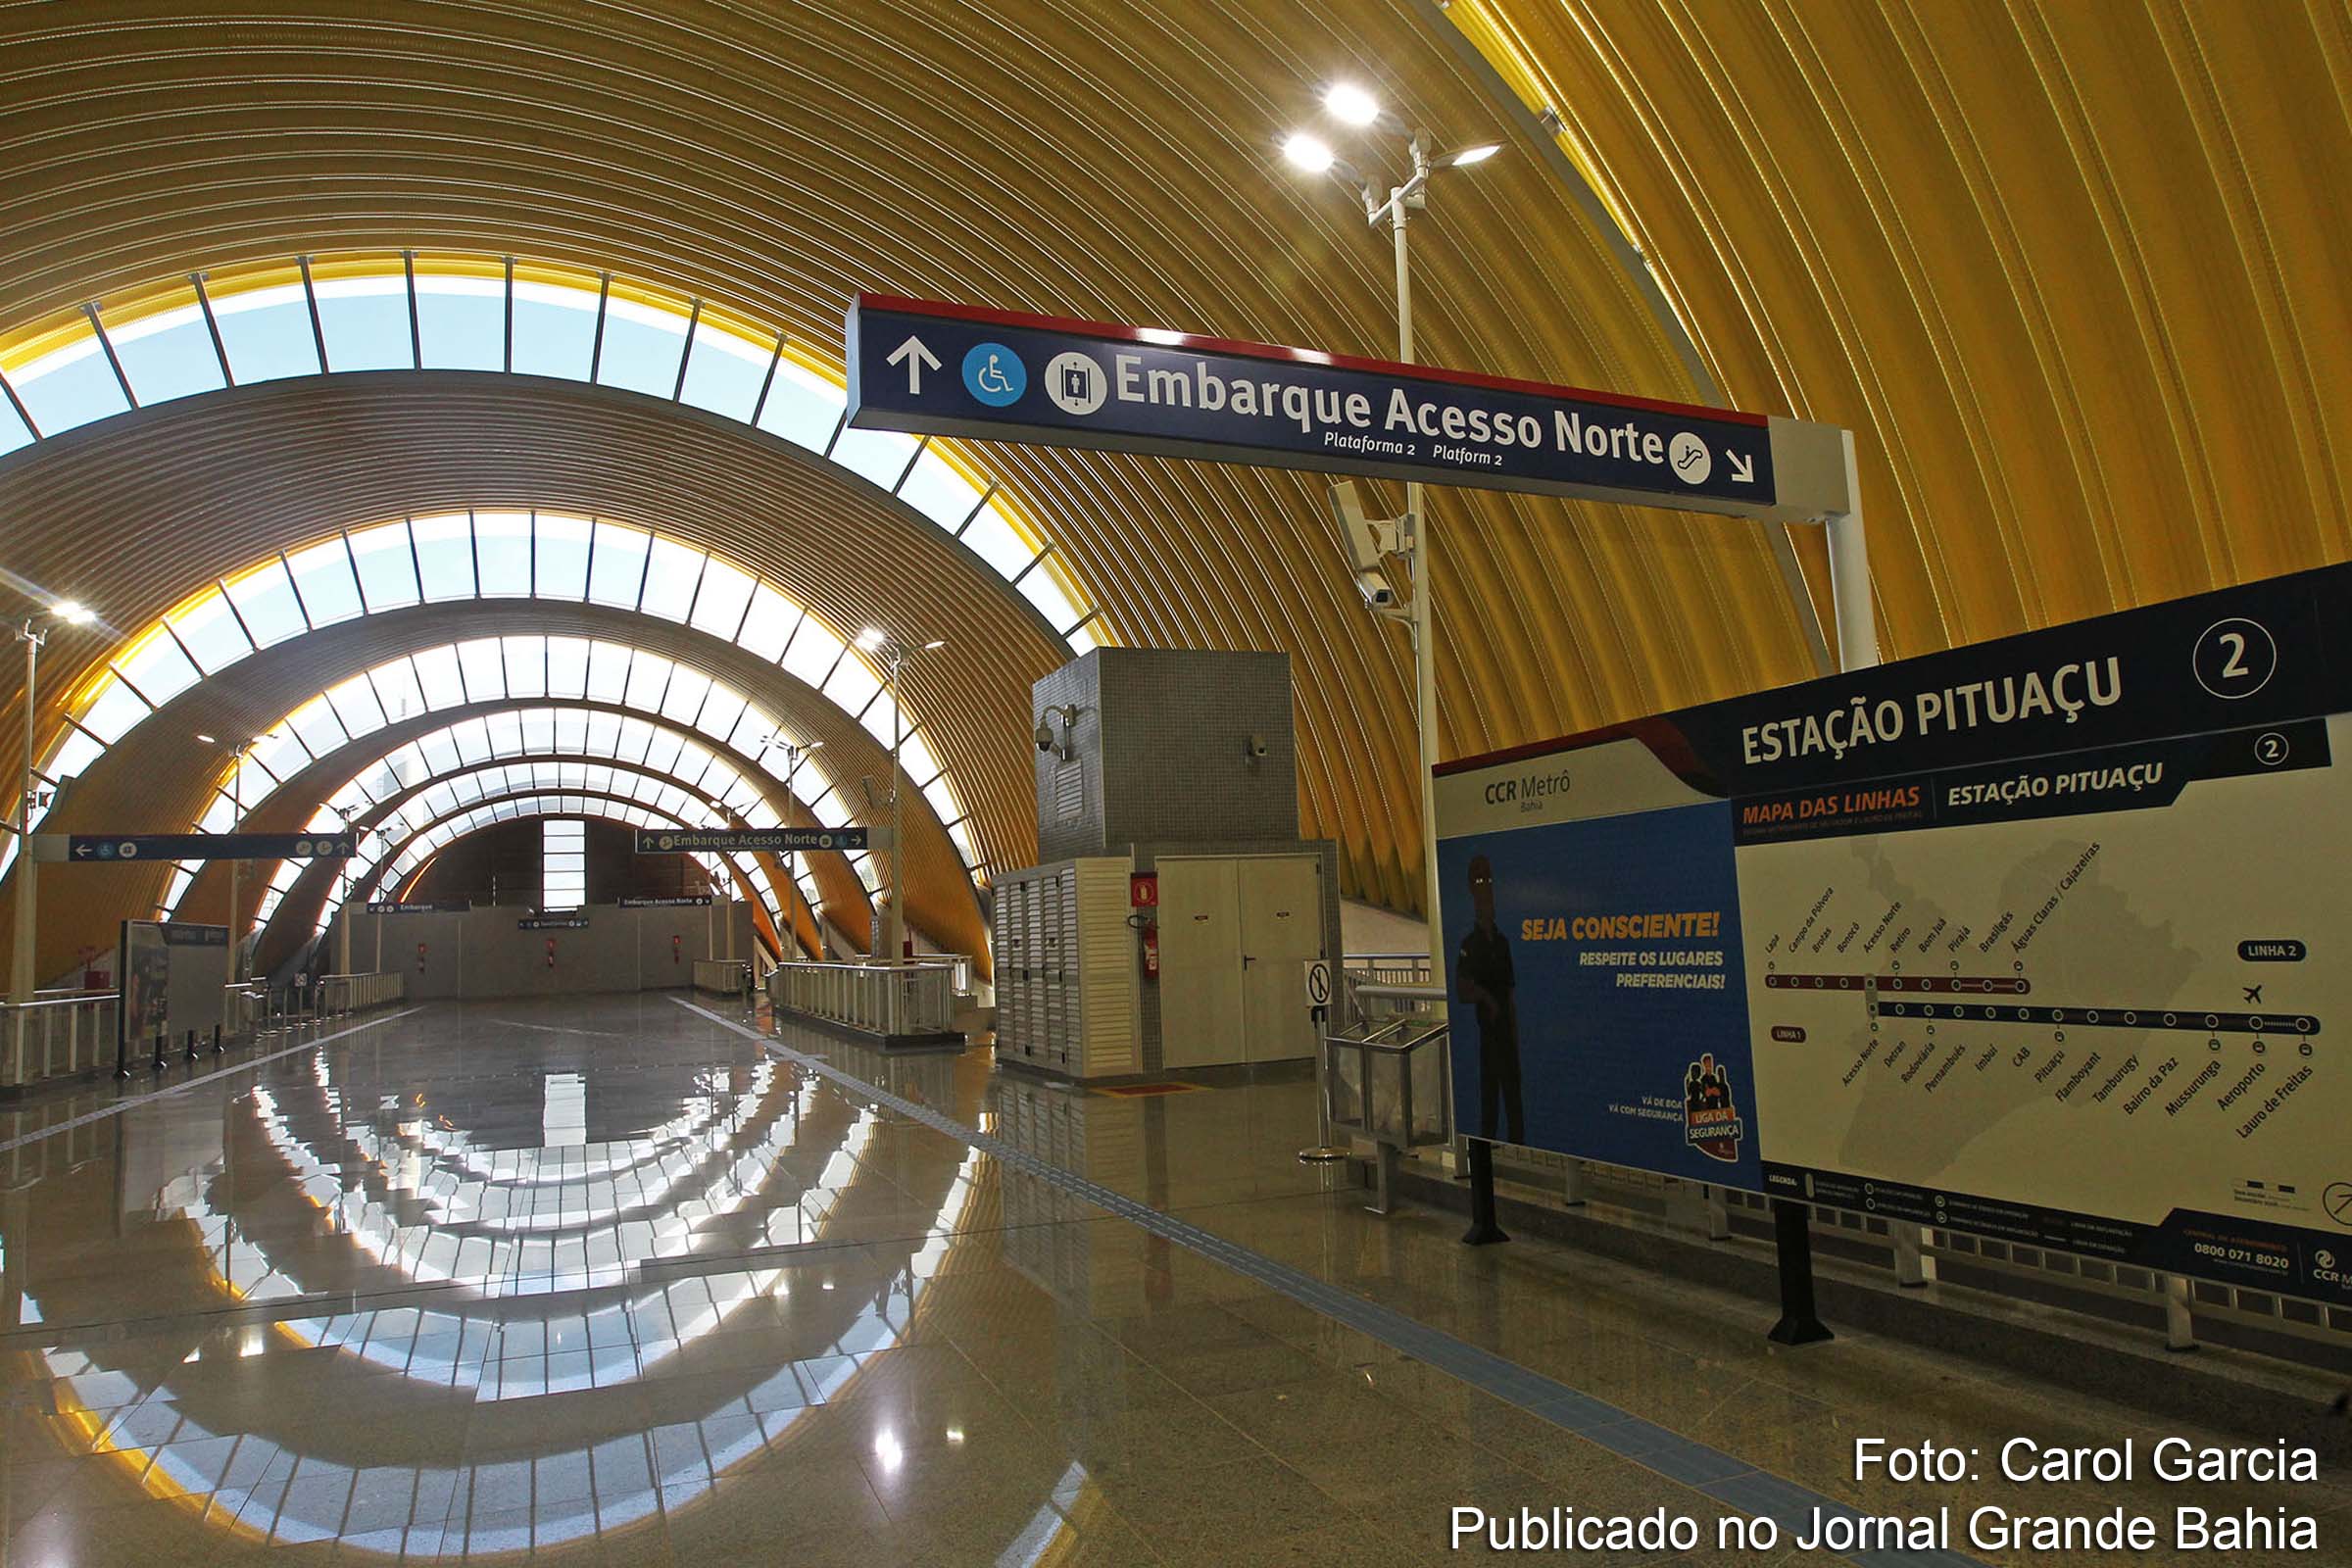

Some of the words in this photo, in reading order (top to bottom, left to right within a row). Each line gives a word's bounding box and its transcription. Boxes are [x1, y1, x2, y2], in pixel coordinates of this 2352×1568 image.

[1115, 354, 1371, 433] Embarque
[1384, 388, 1542, 448] Acesso
[1553, 410, 1665, 466] Norte
[1324, 431, 1402, 455] Plataforma
[1406, 444, 1416, 456] 2
[1433, 444, 1491, 466] Platform
[1494, 455, 1502, 466] 2
[1741, 696, 1904, 765] ESTAÇÃO
[1916, 656, 2122, 735] PITUAÇU
[2219, 632, 2249, 678] 2
[1485, 781, 1517, 805] CCR
[1520, 770, 1570, 800] Metrô
[1947, 775, 2048, 807] ESTAÇÃO
[2055, 761, 2163, 795] PITUAÇU
[2265, 740, 2278, 758] 2
[1520, 801, 1544, 812] Bahia
[1742, 801, 1793, 825] MAPA
[1800, 798, 1838, 819] DAS
[1843, 786, 1921, 814] LINHAS
[673, 834, 734, 849] Embarque
[738, 834, 782, 846] Acesso
[785, 833, 817, 845] Norte
[2011, 924, 2037, 954] Águas
[2033, 895, 2059, 925] Claras
[2060, 842, 2101, 891] Cajazeiras
[1521, 918, 1567, 941] SEJA
[1572, 911, 1720, 940] CONSCIENTE!
[1788, 924, 1808, 954] Campo
[1806, 915, 1816, 928] da
[1812, 887, 1835, 917] Pólvora
[1863, 923, 1886, 954] Acesso
[1883, 901, 1902, 925] Norte
[1979, 910, 2014, 954] Brasilgás
[1812, 928, 1833, 954] Brotas
[1889, 927, 1912, 955] Retiro
[1918, 932, 1937, 954] Bom
[1947, 925, 1971, 953] Pirajá
[2248, 946, 2285, 956] LINHA
[2288, 946, 2296, 956] 2
[1580, 952, 1637, 965] RESPEITE
[1640, 952, 1656, 965] OS
[1659, 951, 1724, 966] LUGARES
[1616, 973, 1725, 989] PREFERENCIAIS!
[1777, 1030, 1795, 1039] LINHA
[1842, 1059, 1862, 1087] Acesso
[1860, 1039, 1880, 1062] Norte
[1884, 1040, 1907, 1068] Detran
[1900, 1042, 1936, 1084] Rodoviária
[1925, 1044, 1966, 1094] Pernambués
[2013, 1047, 2031, 1068] CAB
[2034, 1050, 2066, 1084] Pituaçu
[2055, 1052, 2102, 1102] Flamboyant
[2092, 1054, 2139, 1103] Tamburugy
[2123, 1085, 2152, 1115] Bairro
[2150, 1075, 2163, 1089] da
[2158, 1056, 2180, 1077] Paz
[2165, 1059, 2222, 1116] Mussurunga
[2217, 1062, 2266, 1111] Aeroporto
[1695, 1113, 1713, 1123] LIGA
[1715, 1112, 1729, 1122] DA
[2235, 1110, 2267, 1139] Lauro
[2264, 1097, 2280, 1113] de
[2276, 1065, 2314, 1100] Freitas
[1690, 1125, 1739, 1139] SEGURANÇA
[2193, 1243, 2225, 1257] 0800
[2229, 1249, 2251, 1261] 071
[2256, 1253, 2289, 1269] 8020
[2313, 1268, 2339, 1282] CCR
